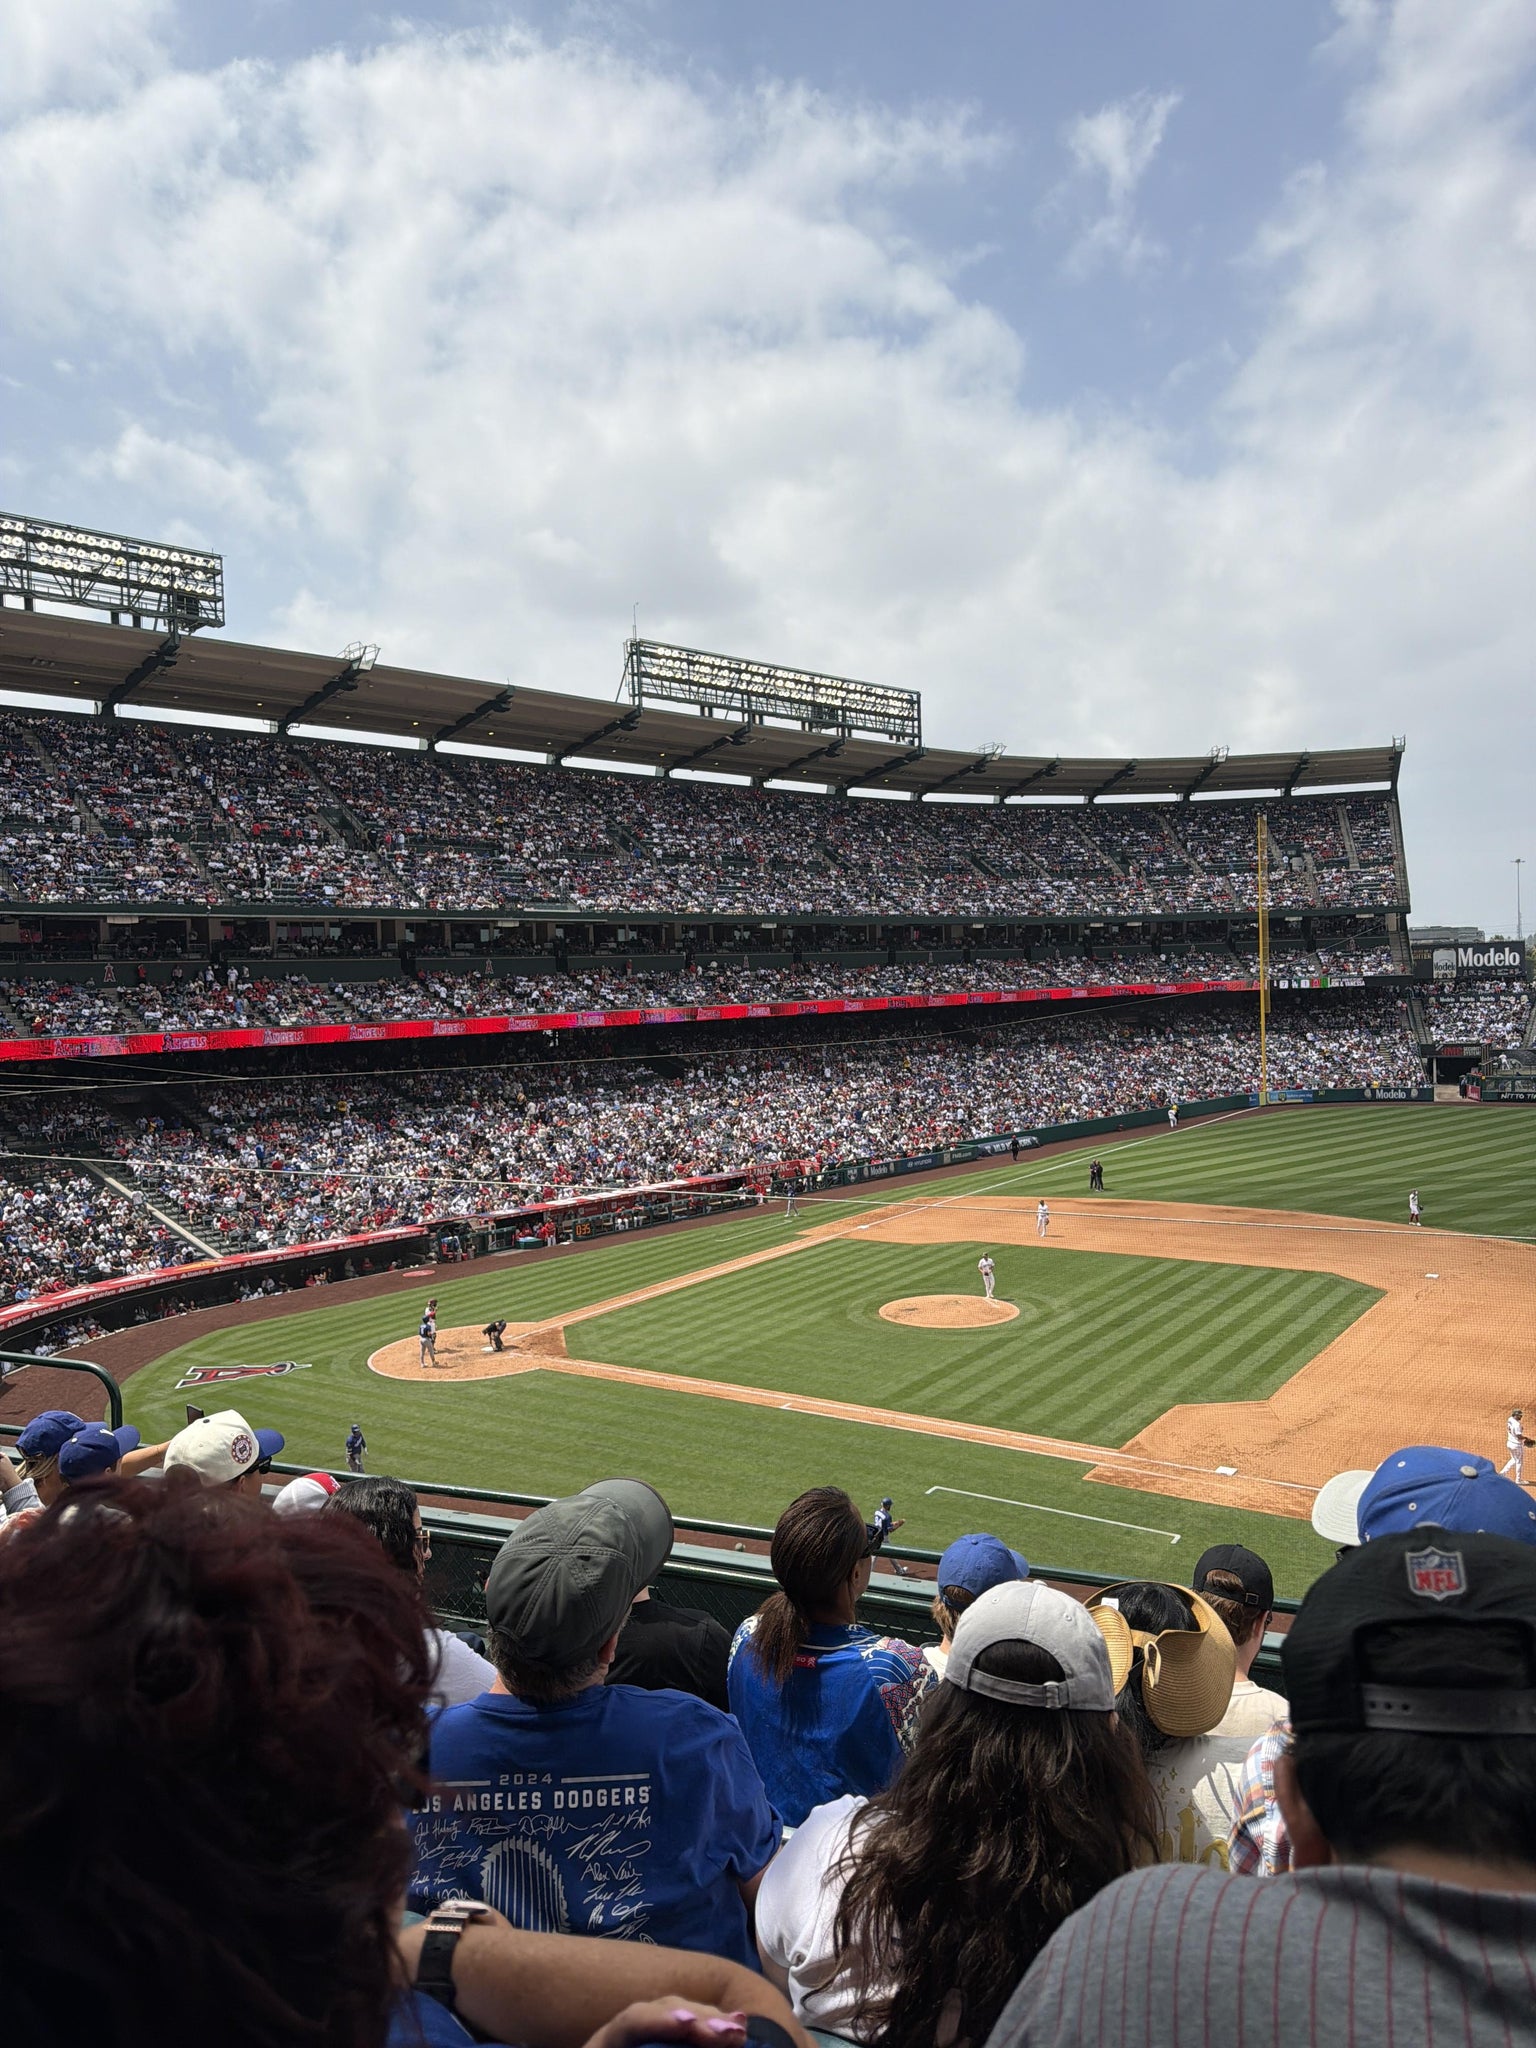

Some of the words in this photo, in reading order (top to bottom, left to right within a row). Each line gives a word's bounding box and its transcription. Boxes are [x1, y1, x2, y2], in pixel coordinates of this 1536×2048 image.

[1458, 947, 1520, 967] Modelo
[350, 1024, 385, 1039] ANGELS
[433, 1019, 466, 1034] ANGELS
[162, 1032, 206, 1051] ANGELS
[264, 1028, 304, 1045] ANGELS
[1376, 1089, 1406, 1099] Modelo
[871, 1165, 888, 1176] Modelo
[1415, 1570, 1459, 1592] NFL
[500, 1773, 553, 1785] 2024
[412, 1795, 442, 1814] OS
[453, 1791, 542, 1811] ANGELES
[554, 1785, 651, 1809] DODGERS
